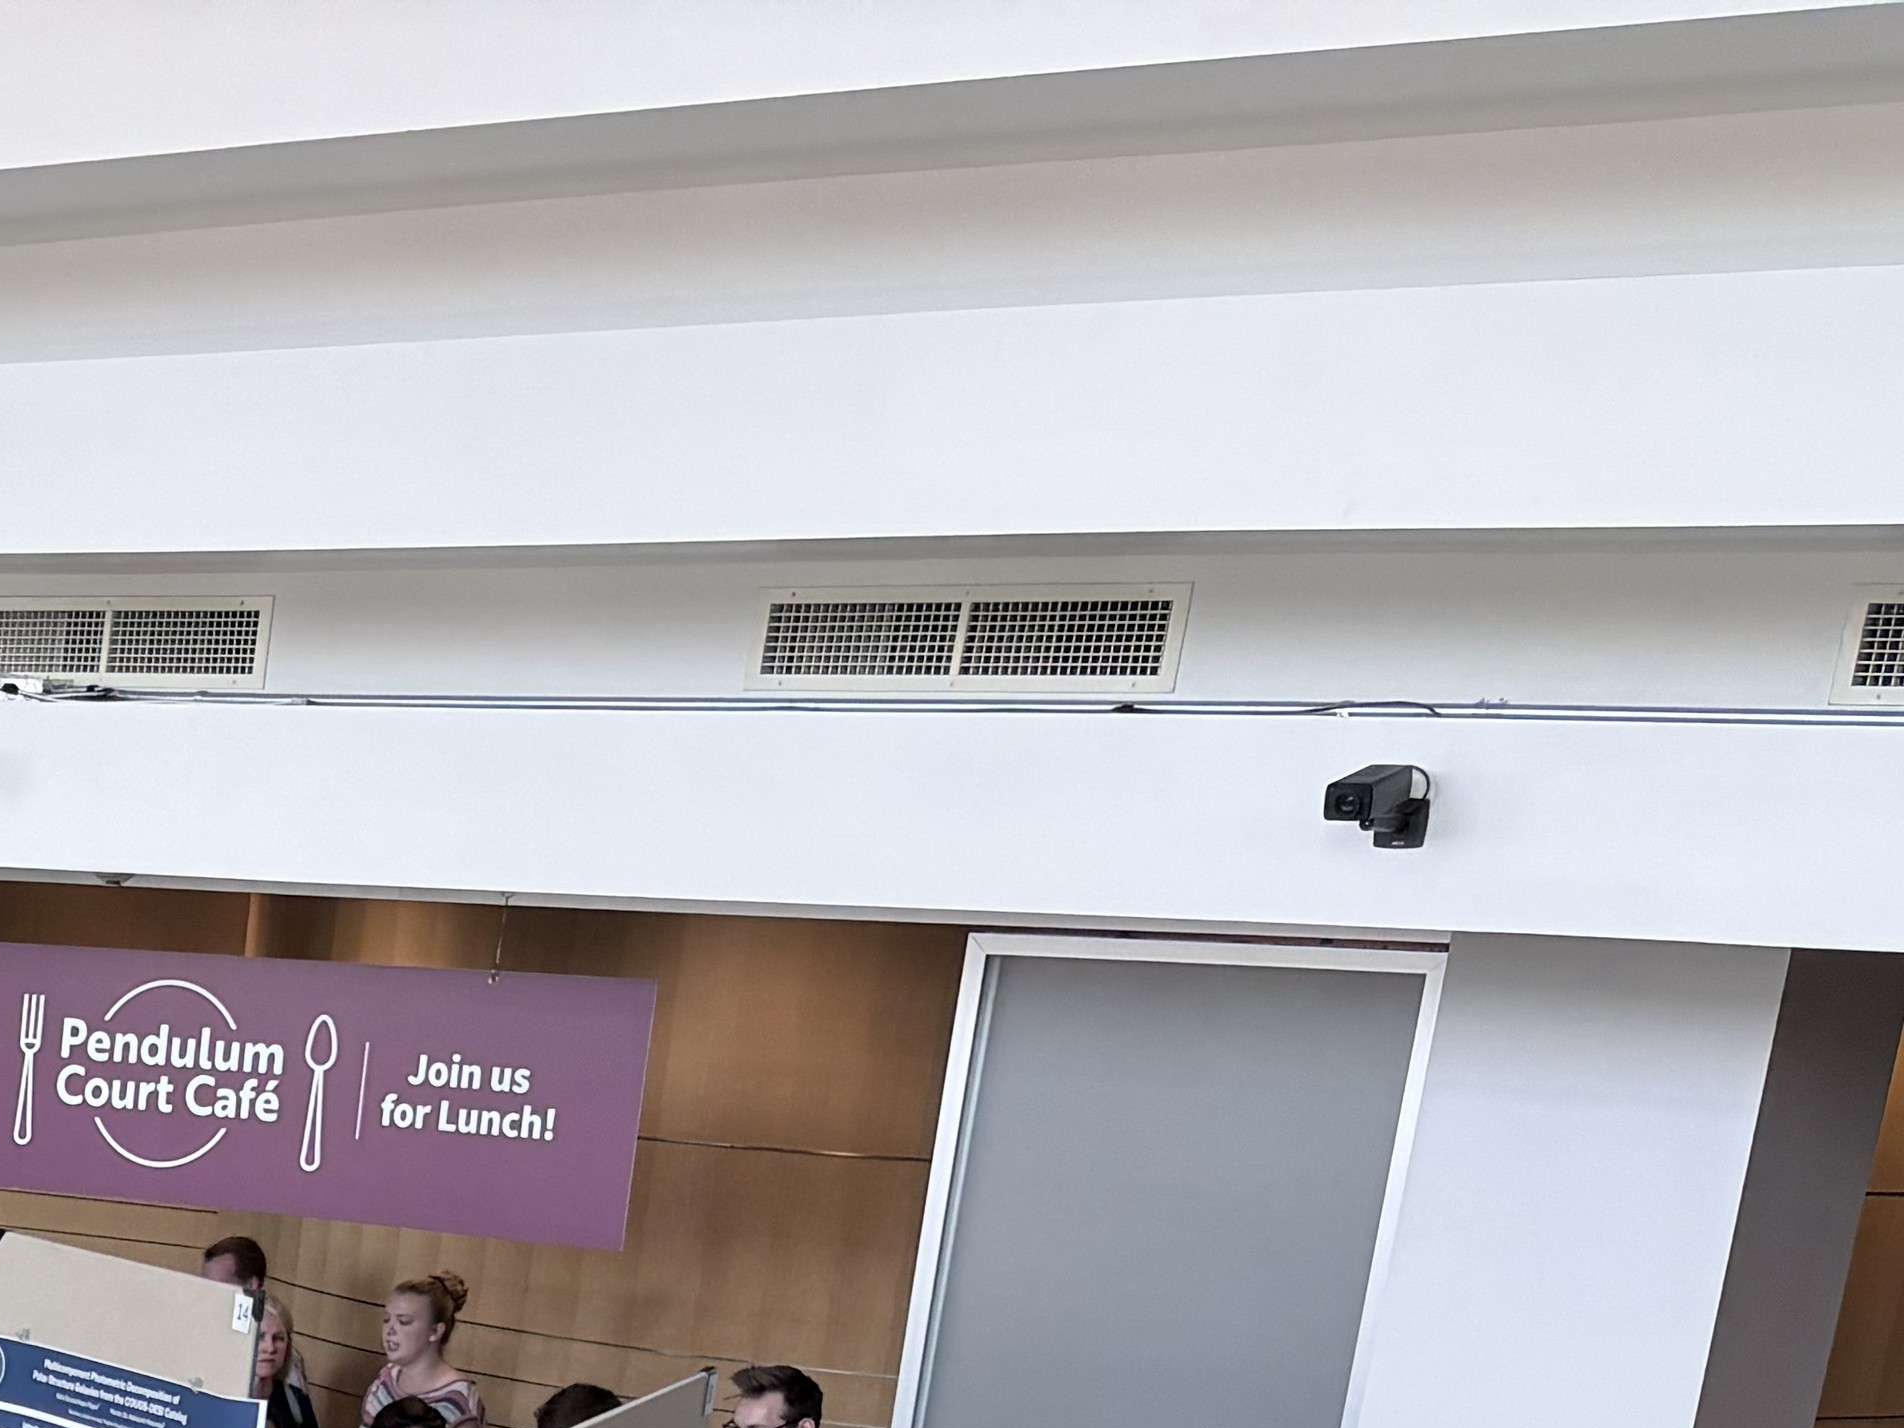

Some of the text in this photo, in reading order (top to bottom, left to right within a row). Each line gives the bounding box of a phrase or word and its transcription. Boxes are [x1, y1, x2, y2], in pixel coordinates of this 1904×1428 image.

[61, 1017, 284, 1075] Pendulum
[56, 1064, 280, 1123] Court Café
[407, 1053, 531, 1094] Join us
[381, 1093, 556, 1141] for Lunch!
[236, 1303, 249, 1322] 14
